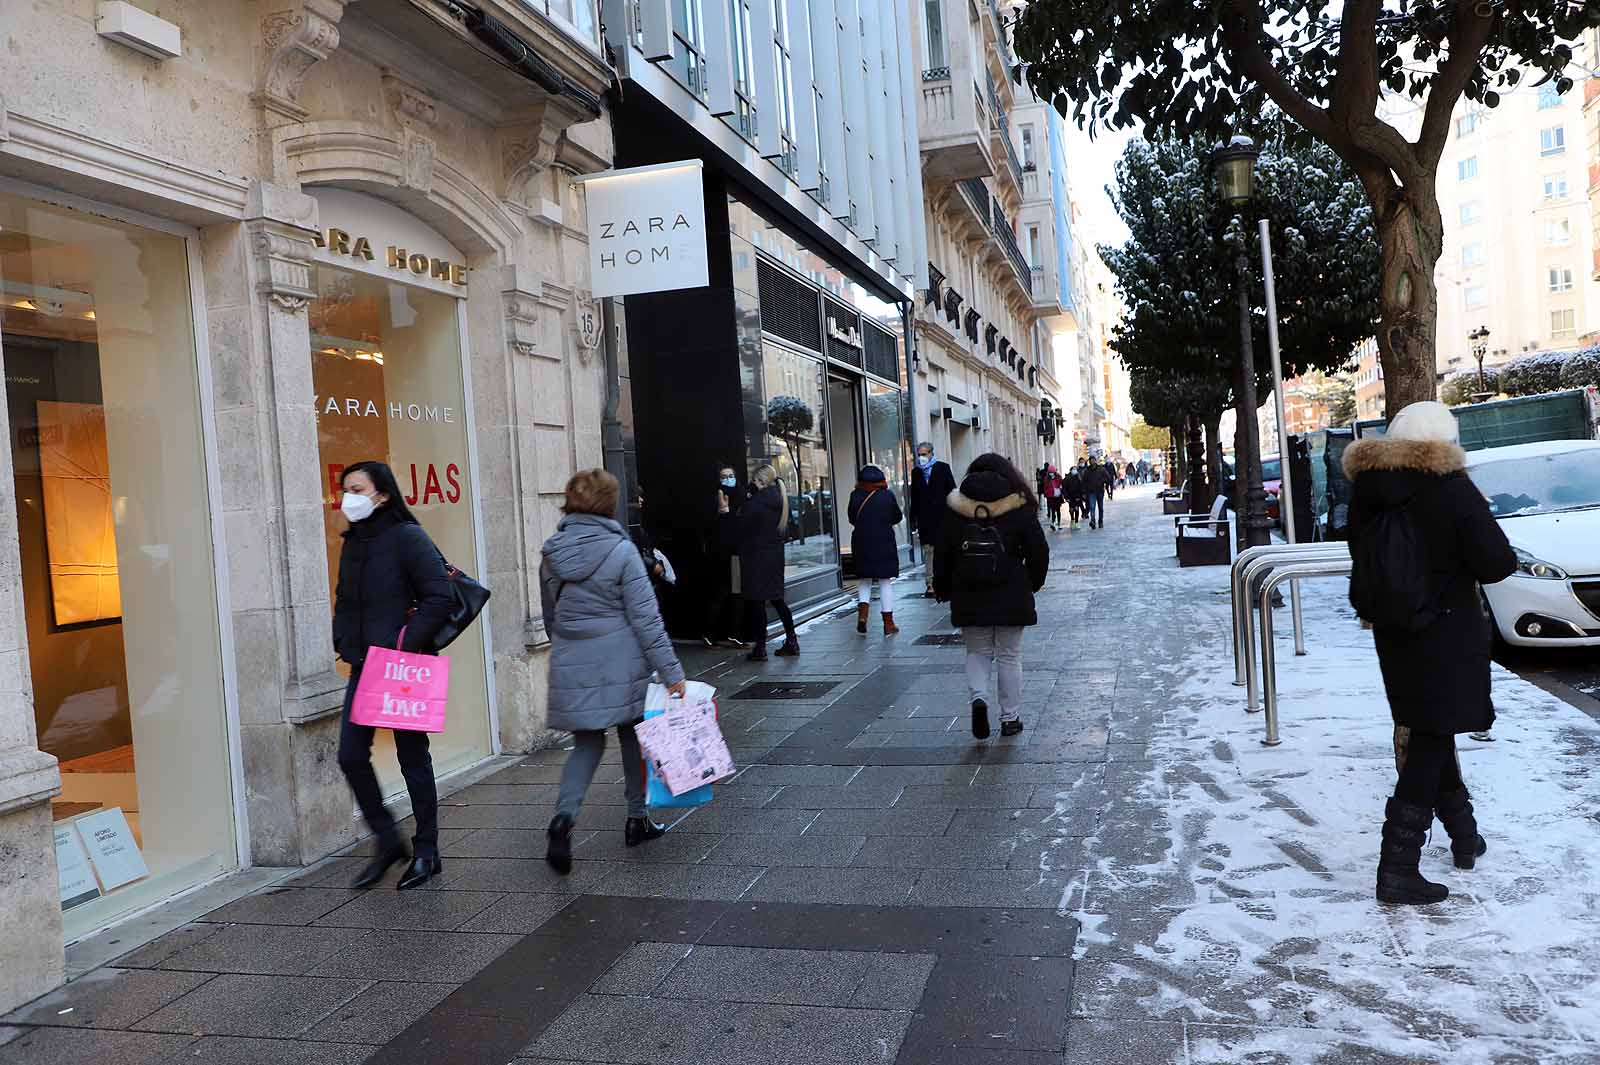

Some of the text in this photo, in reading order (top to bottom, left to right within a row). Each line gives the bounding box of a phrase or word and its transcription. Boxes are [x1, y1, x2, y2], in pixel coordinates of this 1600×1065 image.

[600, 213, 691, 239] ZARA
[386, 245, 468, 287] HOME
[581, 312, 594, 334] 15
[389, 401, 456, 424] HOME
[384, 658, 432, 684] nice
[381, 691, 427, 718] love
